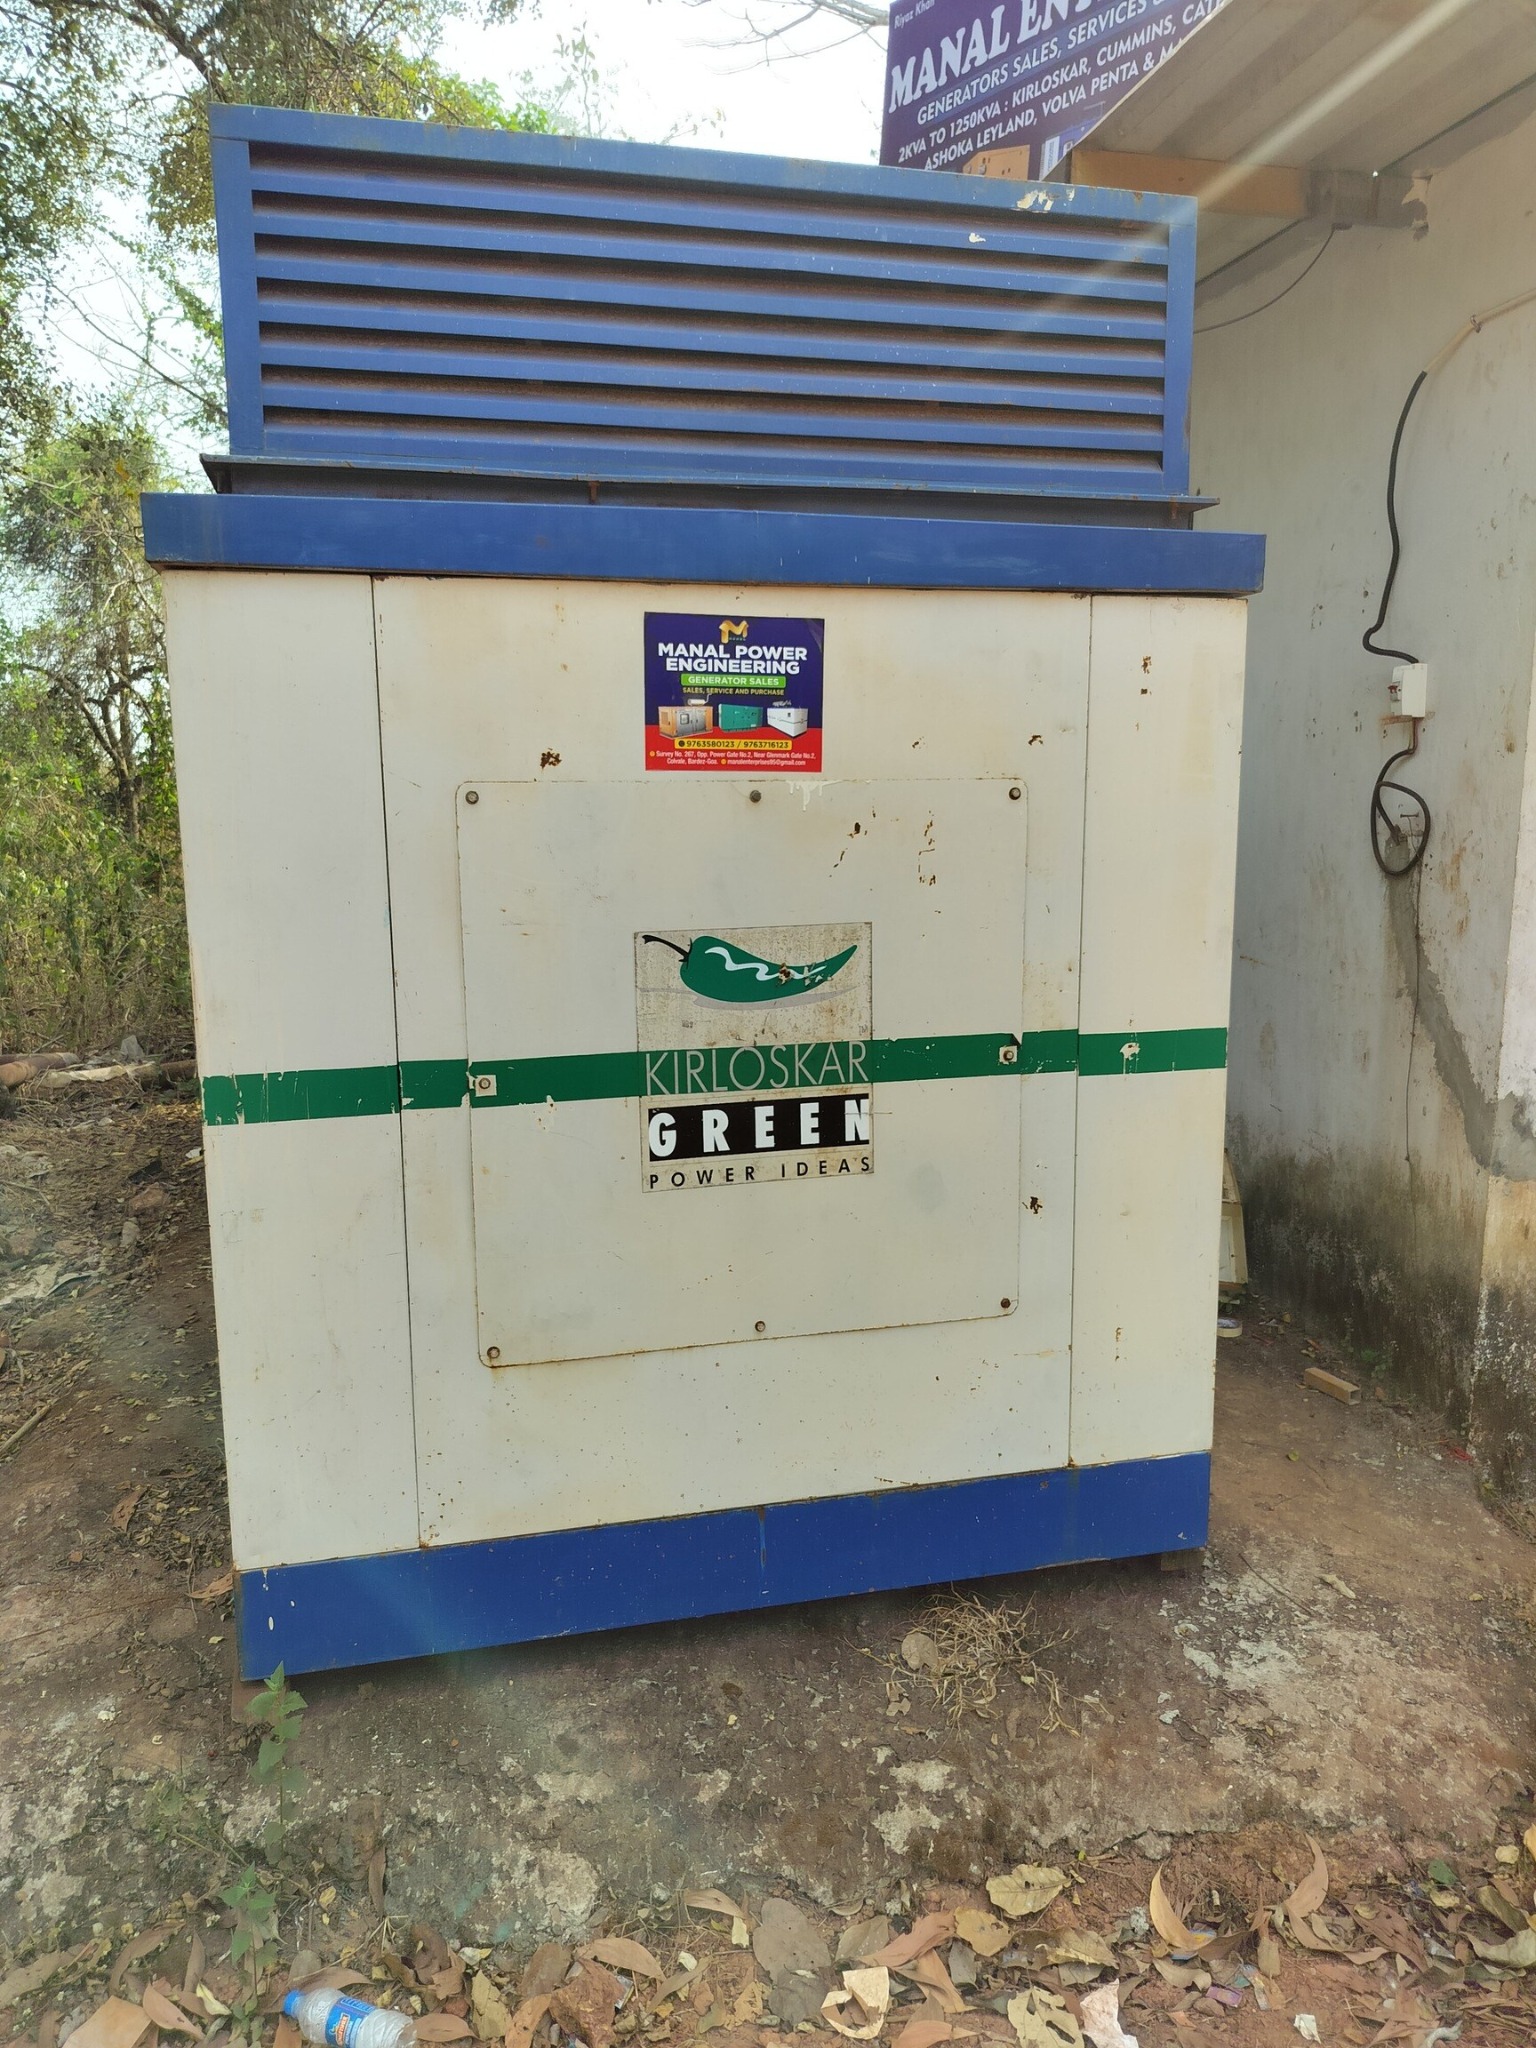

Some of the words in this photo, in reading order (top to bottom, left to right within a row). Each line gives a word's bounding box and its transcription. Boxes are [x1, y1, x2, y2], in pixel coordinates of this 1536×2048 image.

[889, 5, 1010, 114] MANAL
[1017, 0, 1100, 44] EN
[917, 63, 1009, 125] GENERATORS
[1012, 37, 1062, 77] SALES,
[1067, 0, 1147, 49] SERVICES
[898, 137, 926, 163] 2KVA
[929, 127, 946, 148] TO
[950, 101, 1001, 138] 1250KVA
[1012, 57, 1091, 108] KIRLOSKAR,
[1096, 14, 1177, 66] CUMMINS,
[924, 138, 973, 170] ASHOKA
[976, 108, 1037, 149] LEYLAND,
[1042, 82, 1086, 118] VOLVA
[1091, 60, 1139, 96] PENTA
[1143, 51, 1154, 71] &
[658, 642, 730, 658] MANAL
[735, 645, 807, 661] POWER
[666, 657, 800, 674] ENGINEERING
[688, 676, 747, 685] GENERATOR
[749, 677, 779, 686] SALES
[706, 687, 733, 695] SERVICE
[750, 688, 784, 696] PURCHASE
[655, 750, 674, 758] Survey
[686, 740, 735, 748] 9763580123
[743, 741, 789, 749] 9763716123
[645, 1040, 869, 1096] KIRLOSKAR
[648, 1098, 870, 1157] GREEN
[650, 1166, 755, 1189] POWER
[781, 1156, 870, 1178] IDEAS
